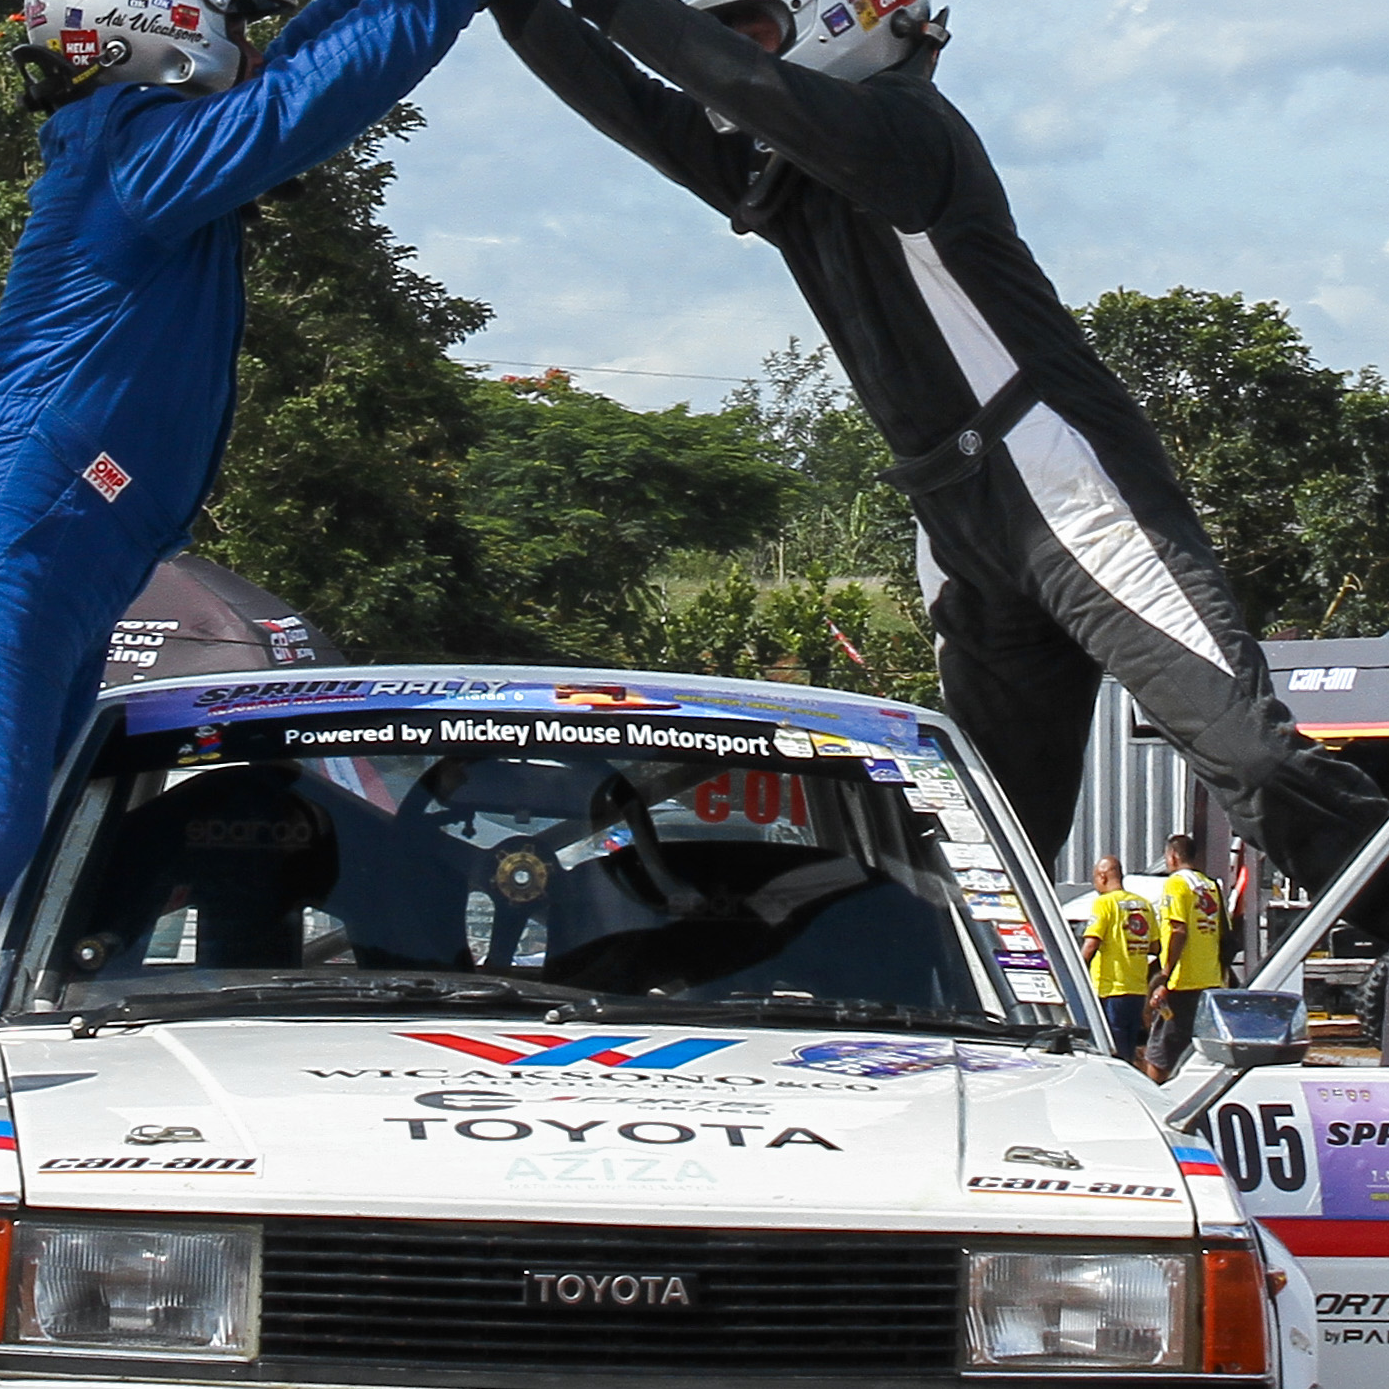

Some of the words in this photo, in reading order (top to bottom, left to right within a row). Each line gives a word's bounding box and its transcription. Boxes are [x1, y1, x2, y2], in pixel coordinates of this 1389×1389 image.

[94, 7, 128, 28] Adi
[129, 13, 206, 44] Wicaksono
[65, 42, 96, 54] HELM
[72, 54, 91, 66] OK
[95, 460, 125, 489] OMP
[369, 680, 511, 697] RALLY
[1287, 667, 1358, 692] can-am
[284, 723, 395, 745] Powered
[400, 722, 433, 745] by
[439, 718, 530, 746] Mickey
[535, 720, 621, 745] Mouse
[626, 723, 771, 758] Motorsport
[300, 1068, 767, 1087] WICAKSONO
[383, 1117, 844, 1152] TOYOTA
[37, 1155, 259, 1171] can-am
[503, 1155, 719, 1183] AZIZA
[965, 1175, 1178, 1199] can-am
[533, 1272, 691, 1306] TOYOTA
[1324, 1330, 1340, 1346] by
